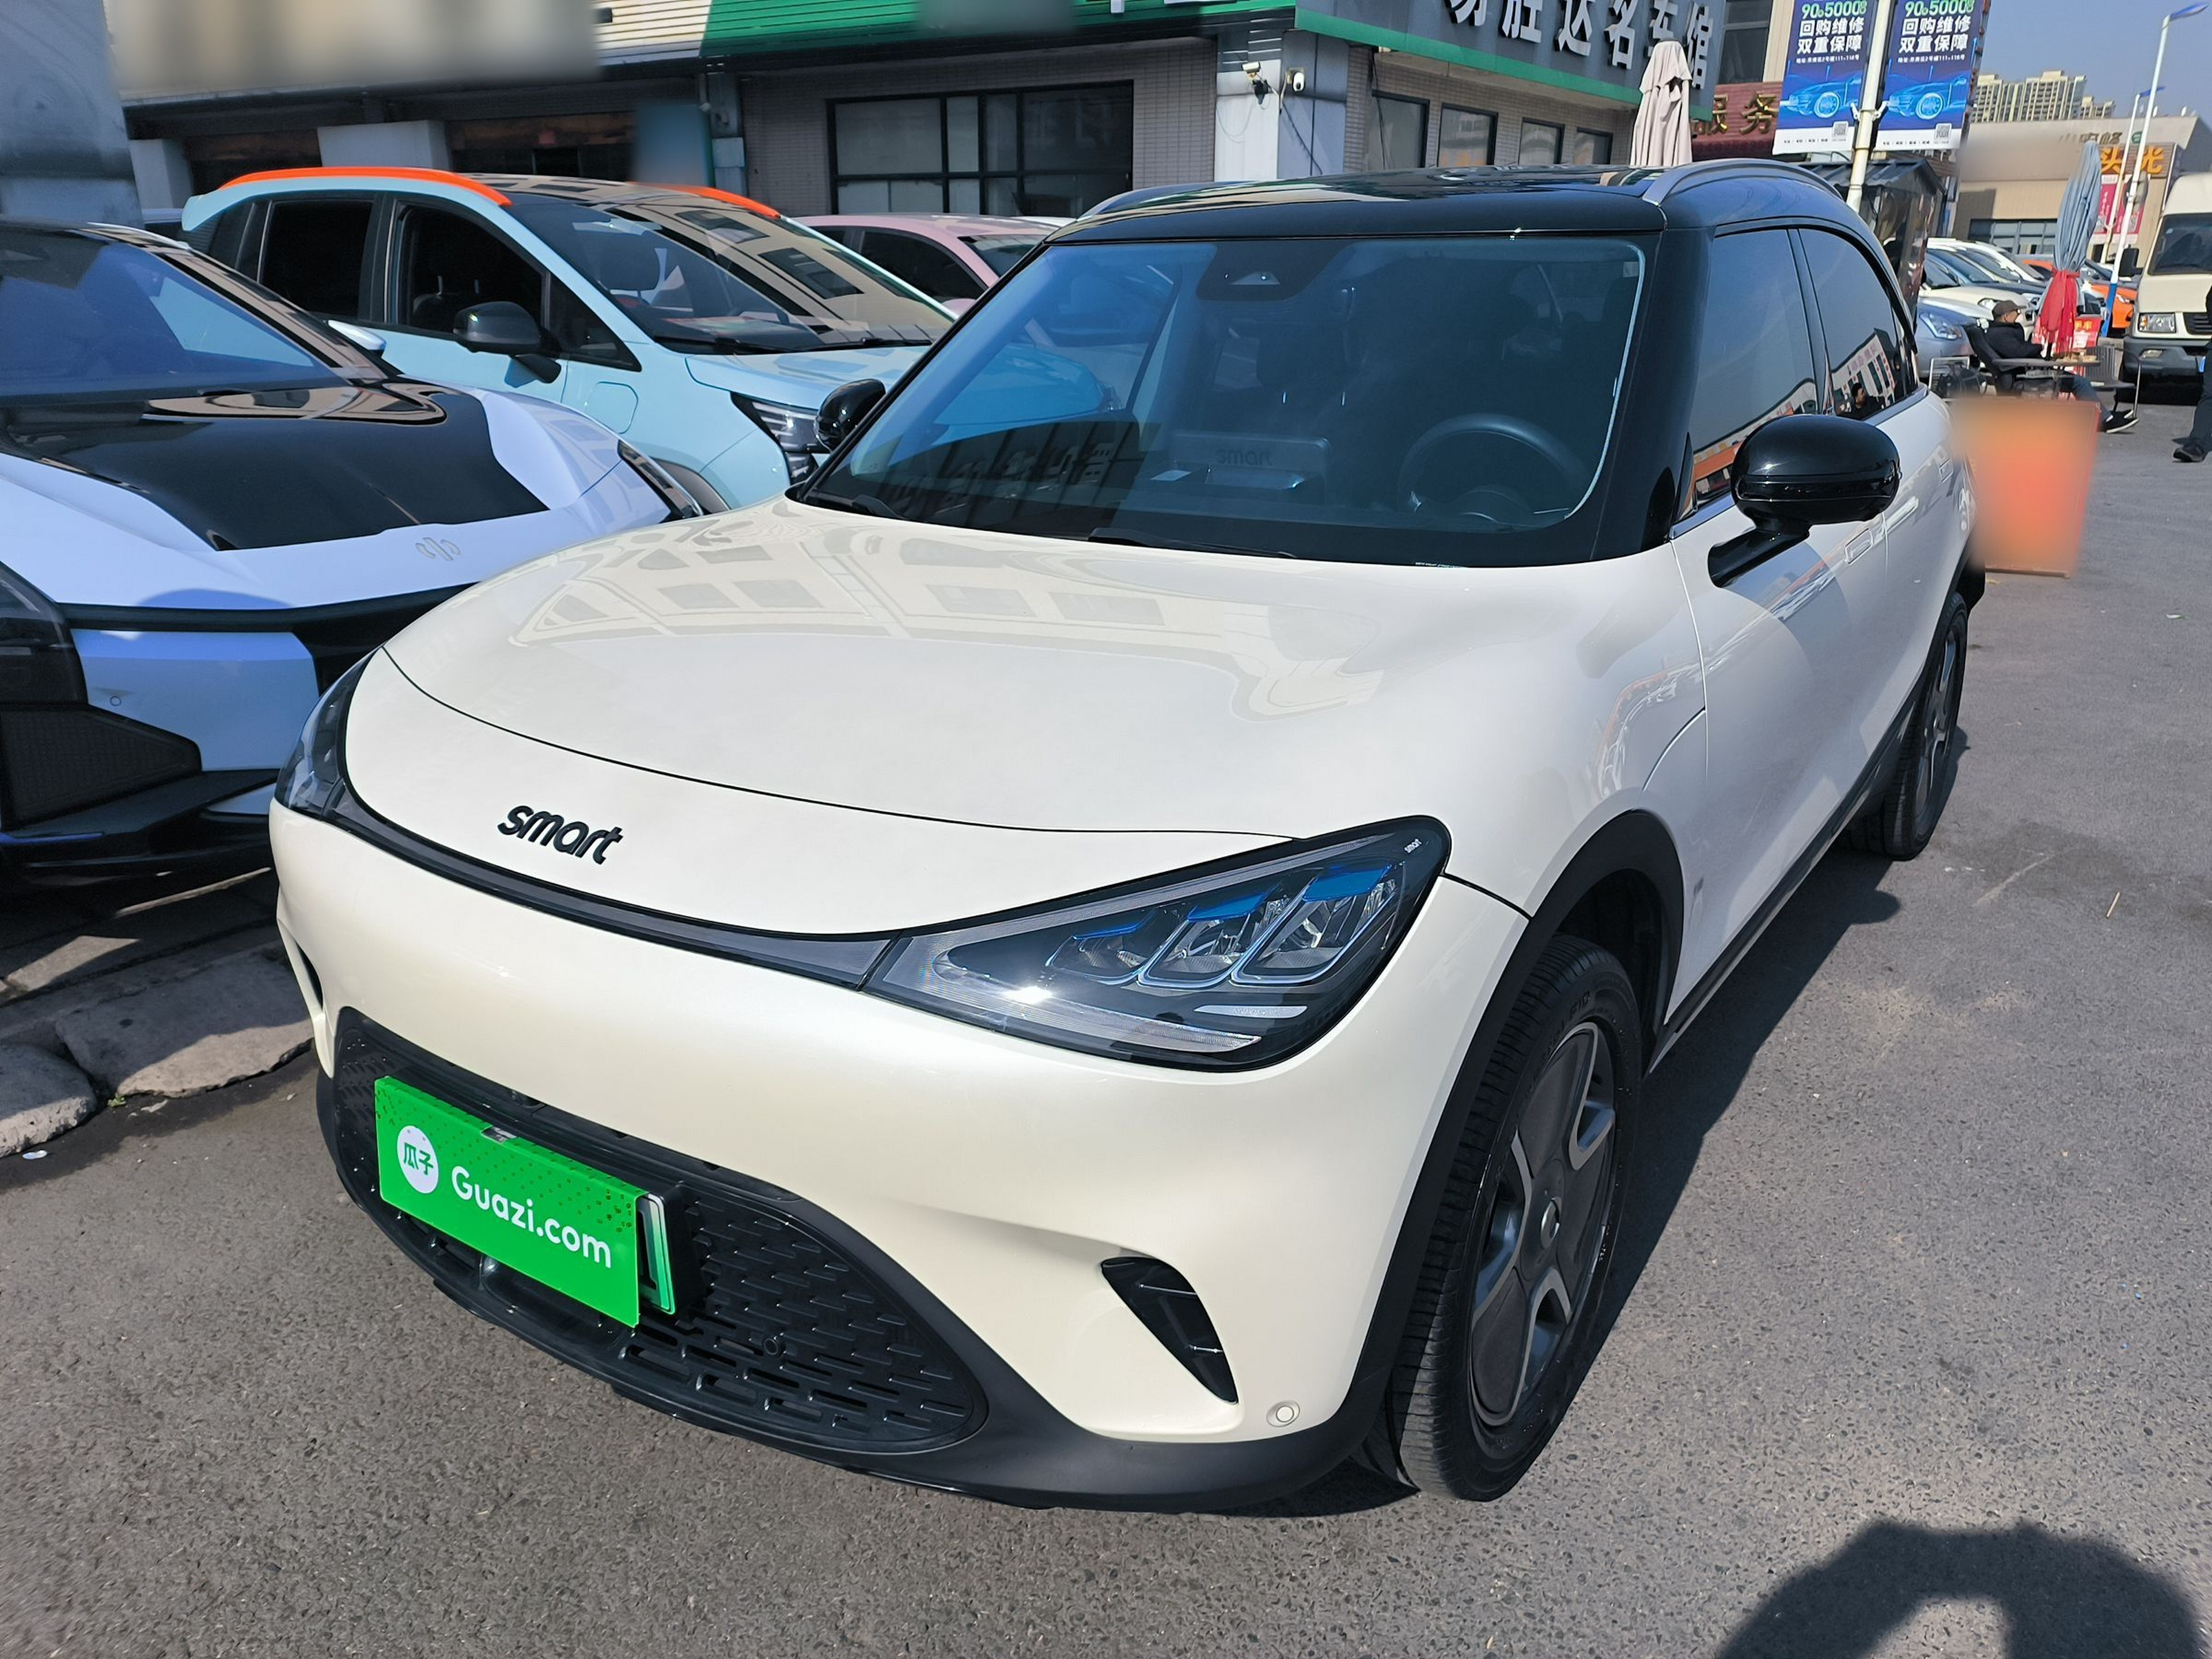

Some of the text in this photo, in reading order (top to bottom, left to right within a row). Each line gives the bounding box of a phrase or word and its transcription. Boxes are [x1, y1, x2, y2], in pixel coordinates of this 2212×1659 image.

[1799, 17, 1865, 37] 回购维修
[1902, 14, 1971, 36] 回购维修
[1797, 35, 1862, 55] 双重保障
[1899, 33, 1968, 54] 双重保障
[1215, 447, 1273, 467] smart
[497, 805, 623, 865] smart
[1404, 838, 1422, 853] smart
[402, 1142, 434, 1177] 瓜子
[451, 1165, 612, 1269] Guazi.com
